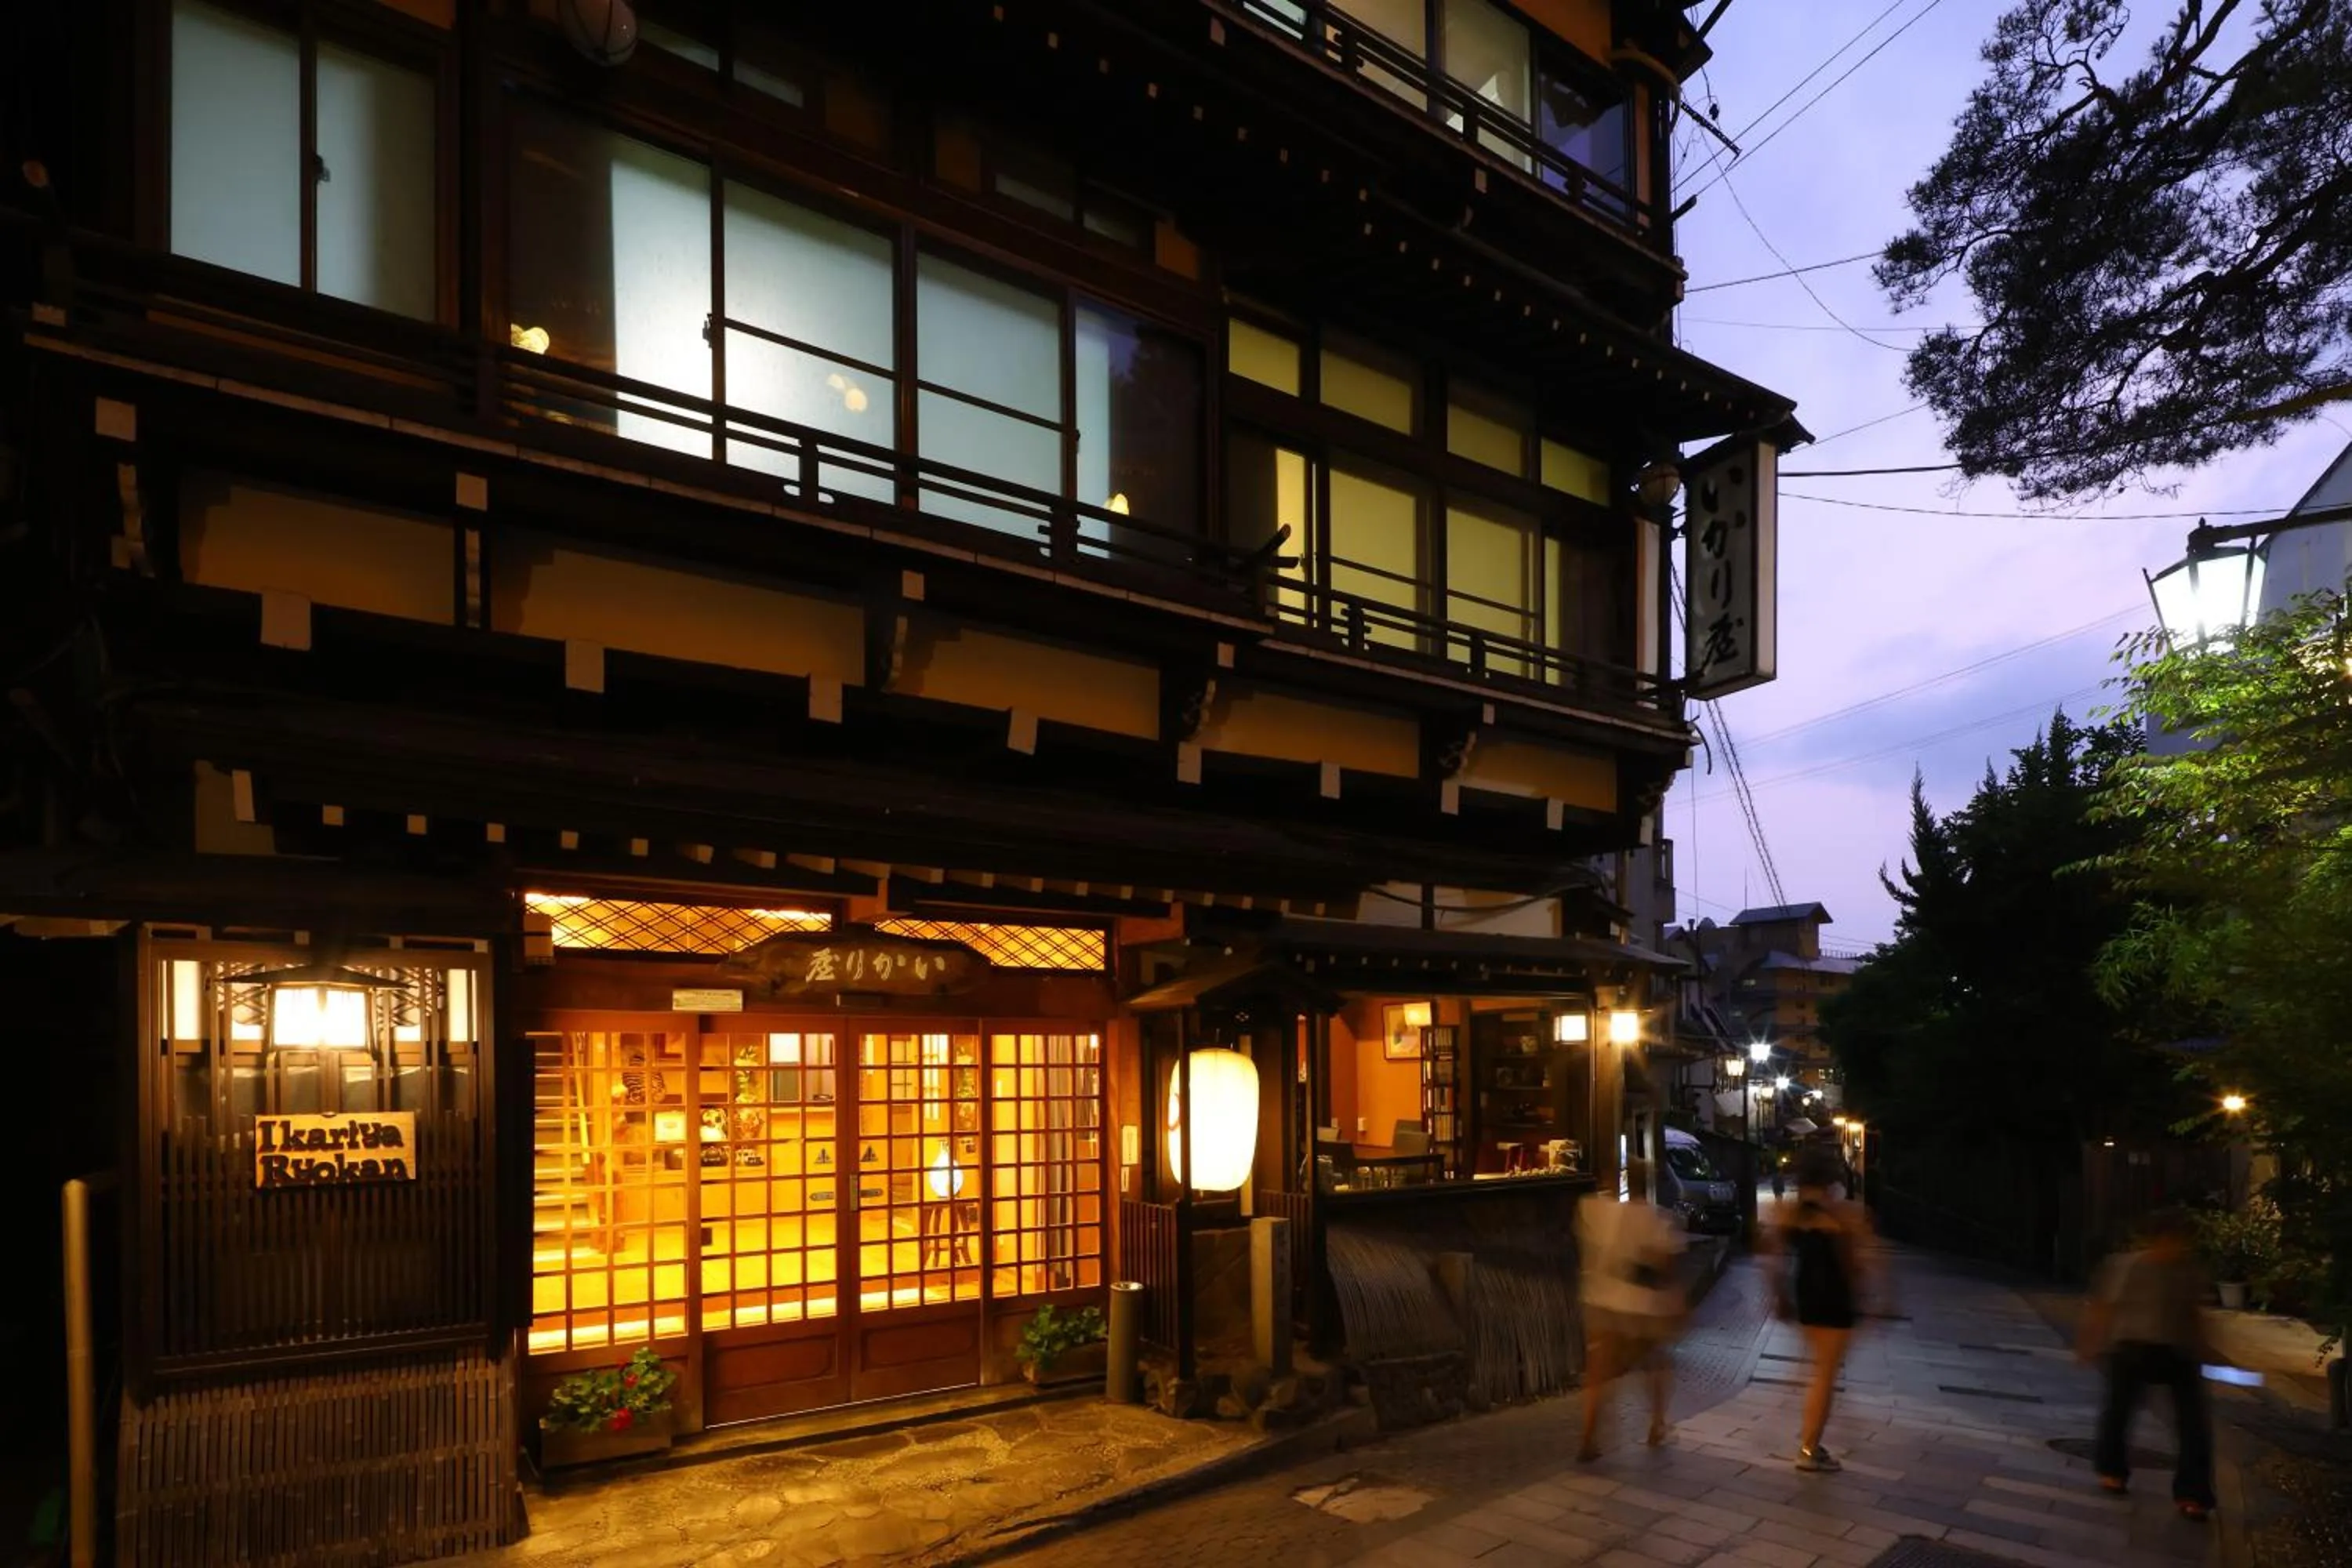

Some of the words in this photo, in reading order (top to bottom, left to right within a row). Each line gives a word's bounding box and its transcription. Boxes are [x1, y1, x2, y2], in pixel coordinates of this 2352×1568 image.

[1700, 466, 1746, 673] いかり屋
[258, 1120, 404, 1153] Ikariya
[259, 1152, 408, 1189] Ryokan
